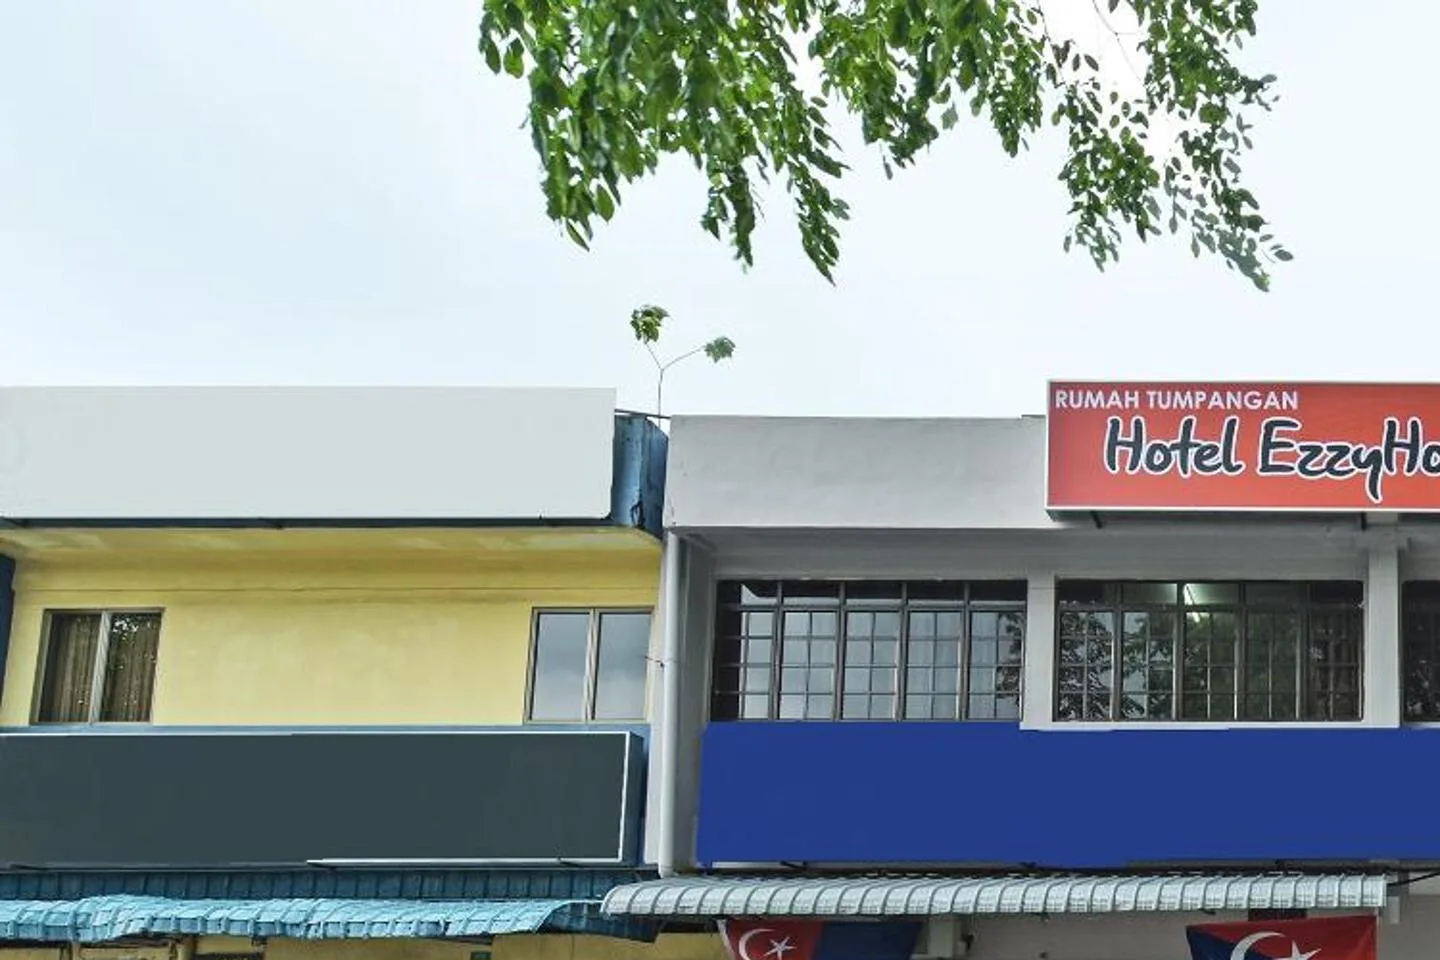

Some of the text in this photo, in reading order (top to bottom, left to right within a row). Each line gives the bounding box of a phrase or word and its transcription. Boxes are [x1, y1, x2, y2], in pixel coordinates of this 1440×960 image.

[1055, 390, 1298, 410] RUMAH TUMPANGAN
[1103, 415, 1246, 479] Hotel
